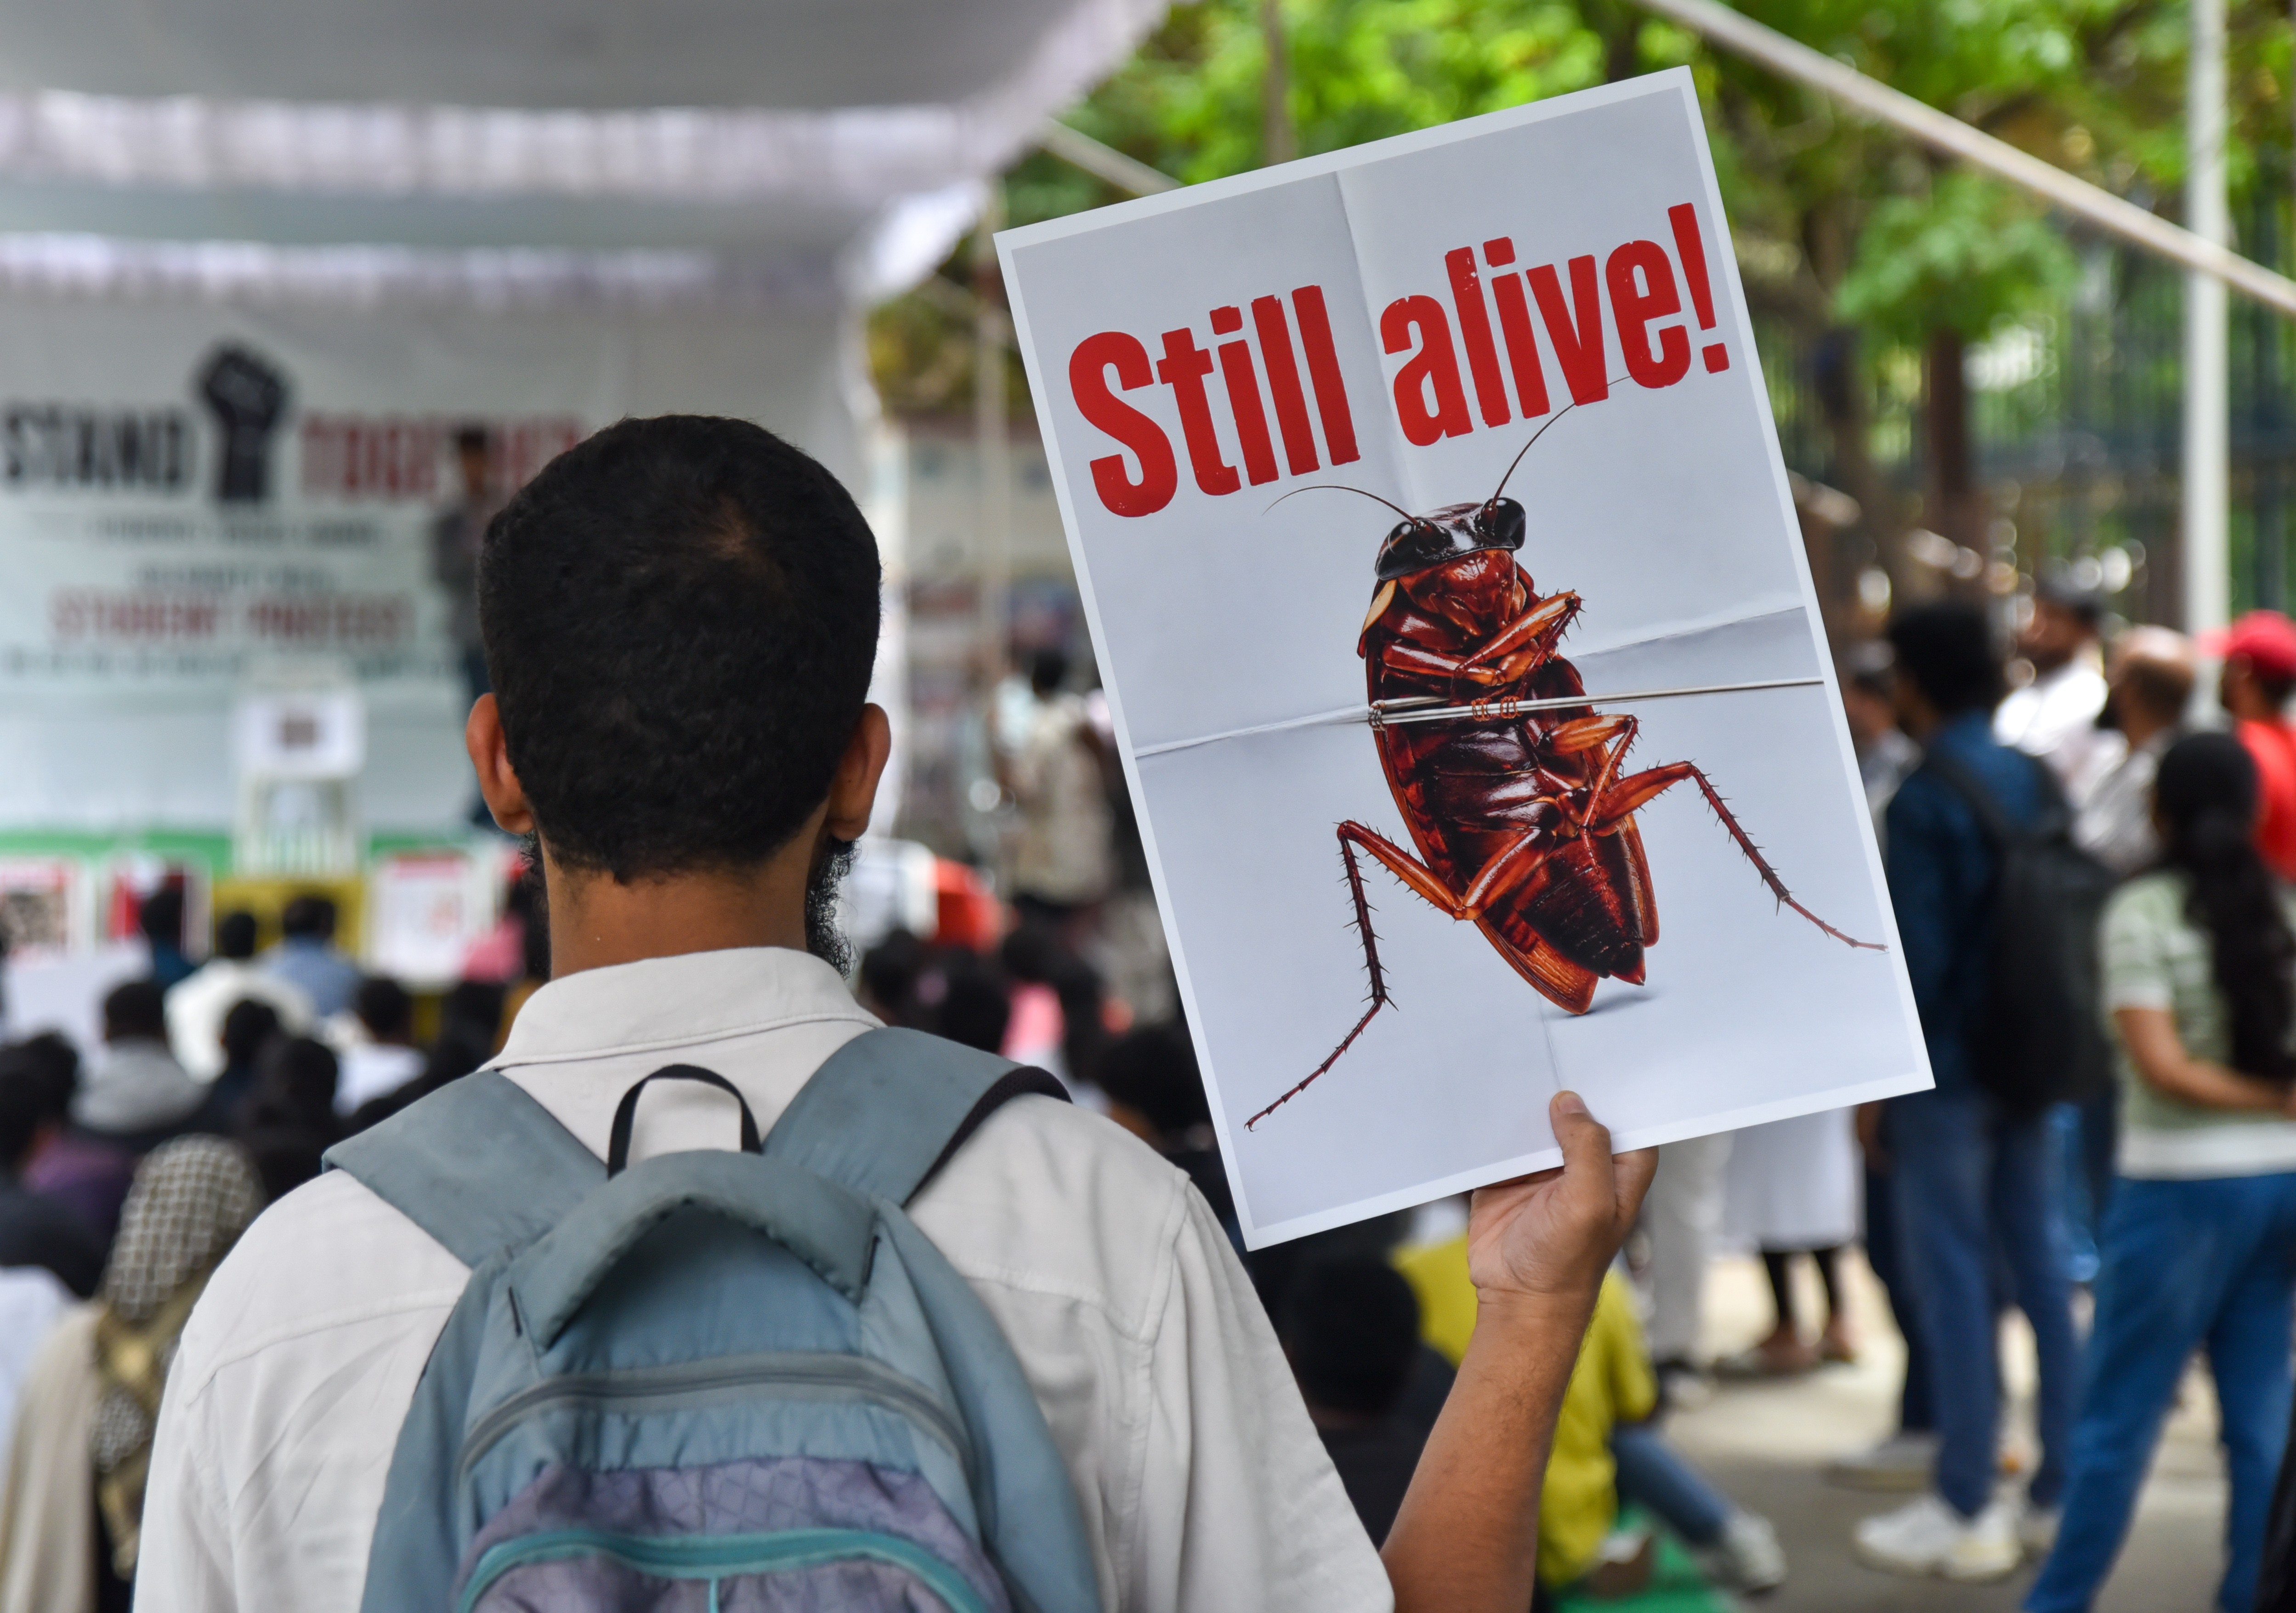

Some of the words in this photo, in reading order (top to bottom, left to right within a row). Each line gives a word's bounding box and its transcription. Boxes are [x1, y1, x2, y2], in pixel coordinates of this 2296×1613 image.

[3, 404, 191, 491] STAND
[1068, 285, 1361, 517] Still
[1380, 202, 1729, 447] alive!
